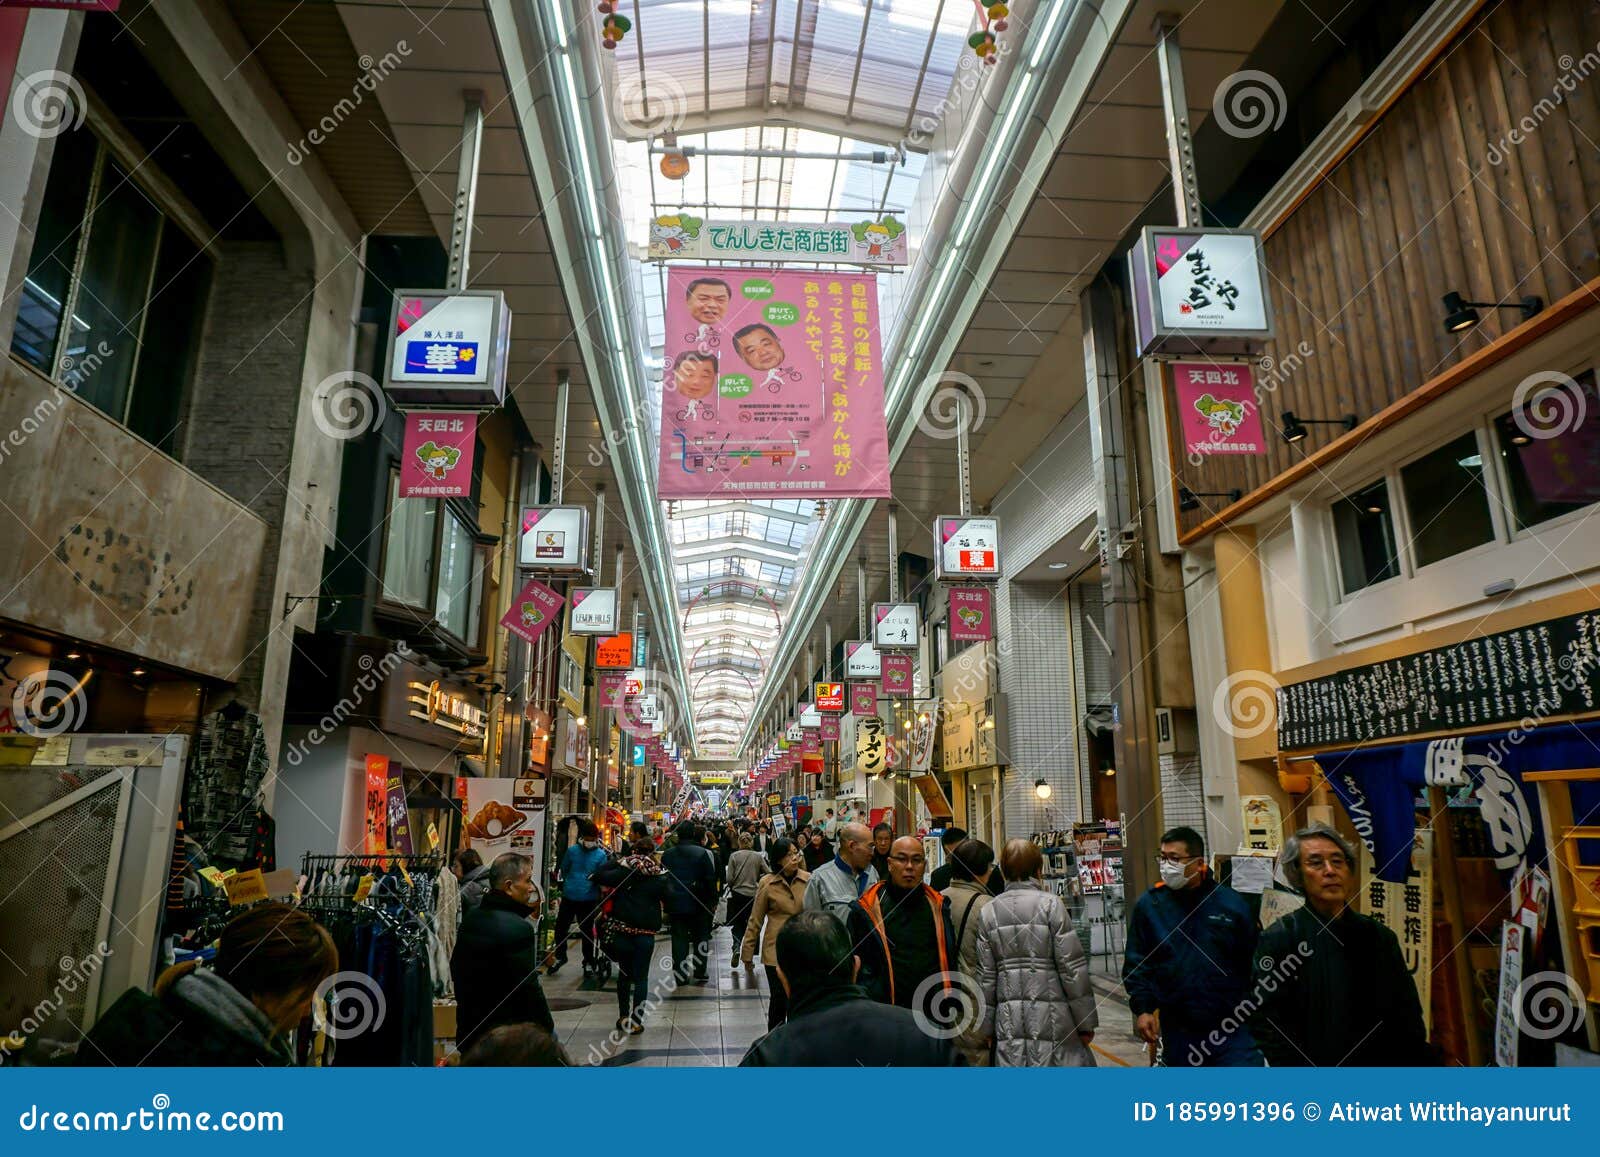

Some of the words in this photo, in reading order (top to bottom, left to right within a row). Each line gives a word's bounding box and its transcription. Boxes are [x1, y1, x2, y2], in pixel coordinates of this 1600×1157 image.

[709, 226, 850, 253] てんしきた商店街
[423, 330, 464, 339] 婦人洋品
[425, 343, 459, 373] 華
[1189, 370, 1239, 385] 天四北
[418, 419, 464, 433] 天四北
[970, 550, 985, 567] 薬
[956, 592, 983, 602] 天四北
[864, 719, 882, 769] ラーメン
